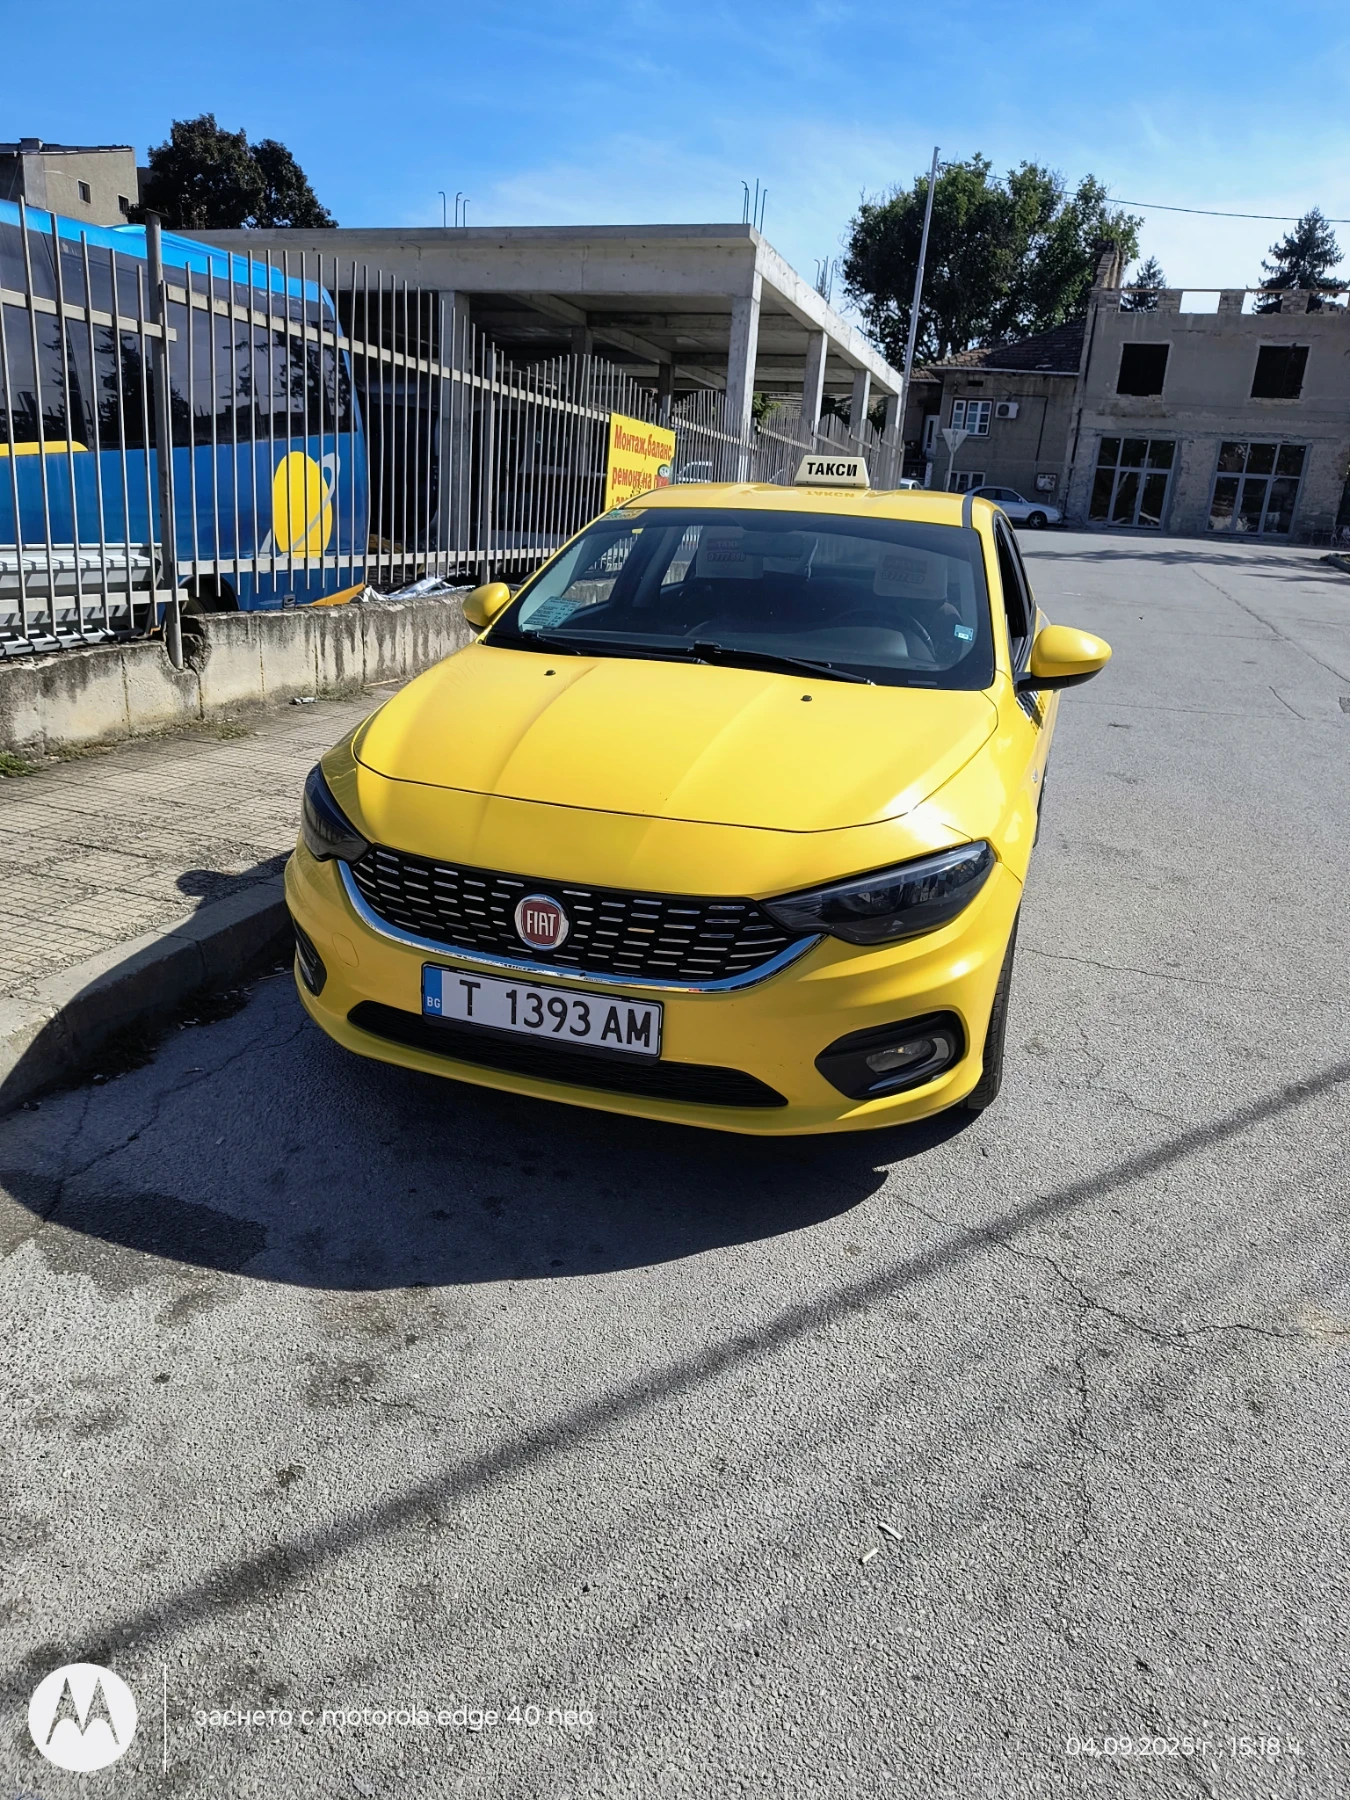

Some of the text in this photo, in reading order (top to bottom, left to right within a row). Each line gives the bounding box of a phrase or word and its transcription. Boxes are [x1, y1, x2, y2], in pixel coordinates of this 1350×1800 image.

[807, 462, 858, 477] ТАКСИ
[526, 910, 557, 937] FIAT
[426, 979, 652, 1048] BG T 1393 AM
